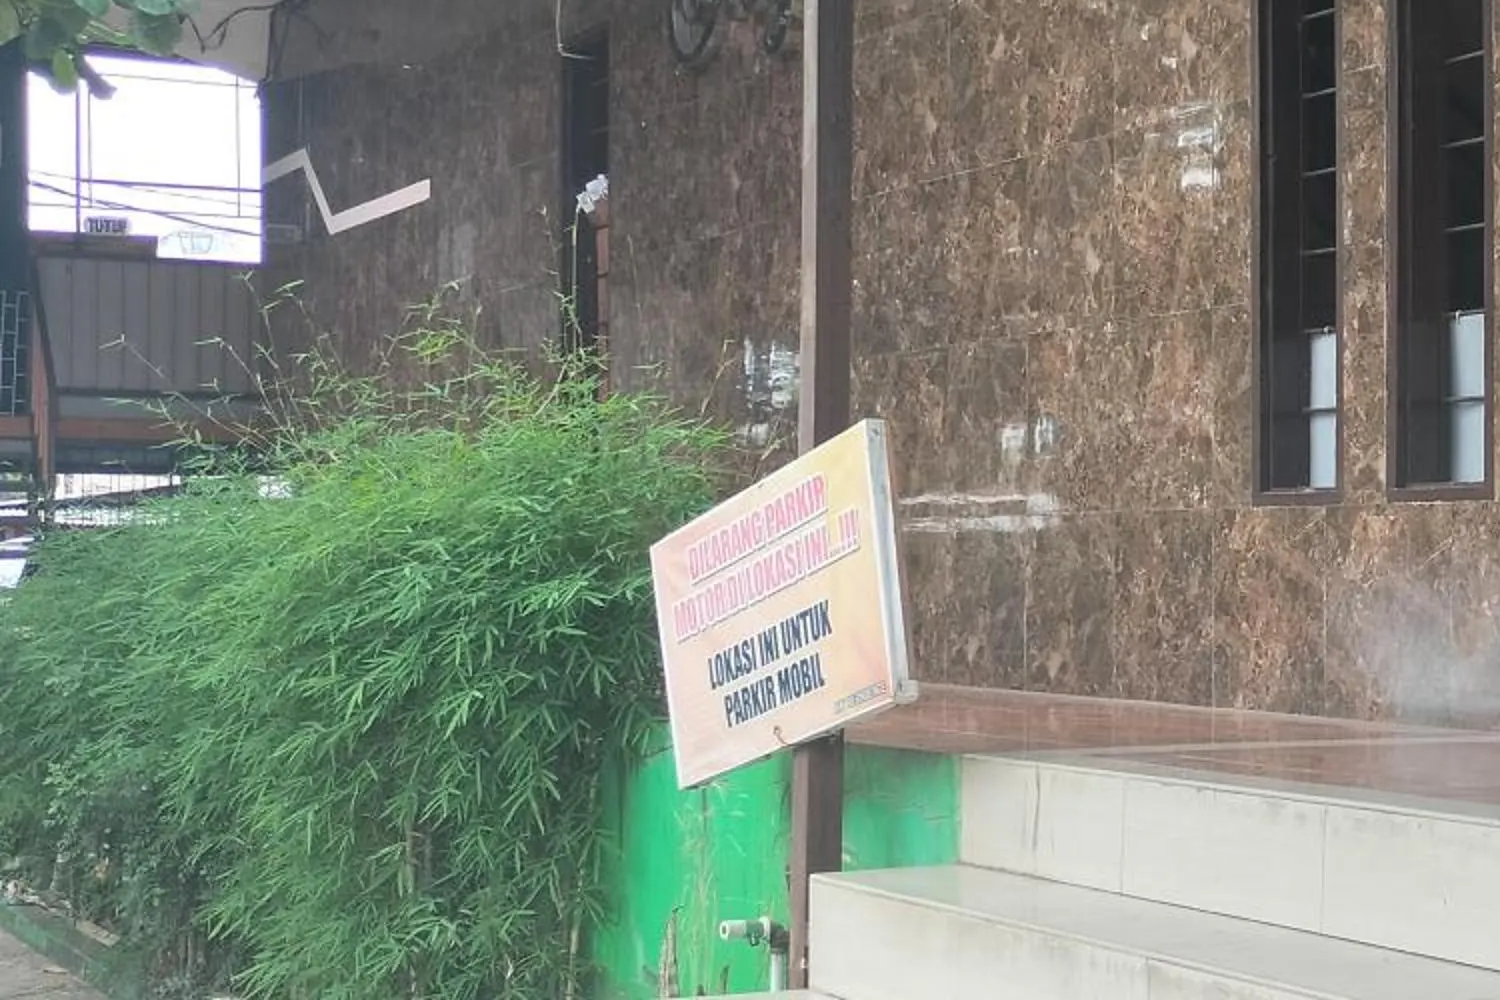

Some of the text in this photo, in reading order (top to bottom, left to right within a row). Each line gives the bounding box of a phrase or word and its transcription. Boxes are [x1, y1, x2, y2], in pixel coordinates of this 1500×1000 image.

[688, 475, 826, 580] DILARANG PARKIR
[673, 583, 728, 637] MOTOR
[745, 537, 803, 602] LOKASI
[707, 599, 833, 690] LOKASI INI UNTUK
[723, 675, 777, 728] PARKIR
[777, 651, 825, 705] MOBIL
